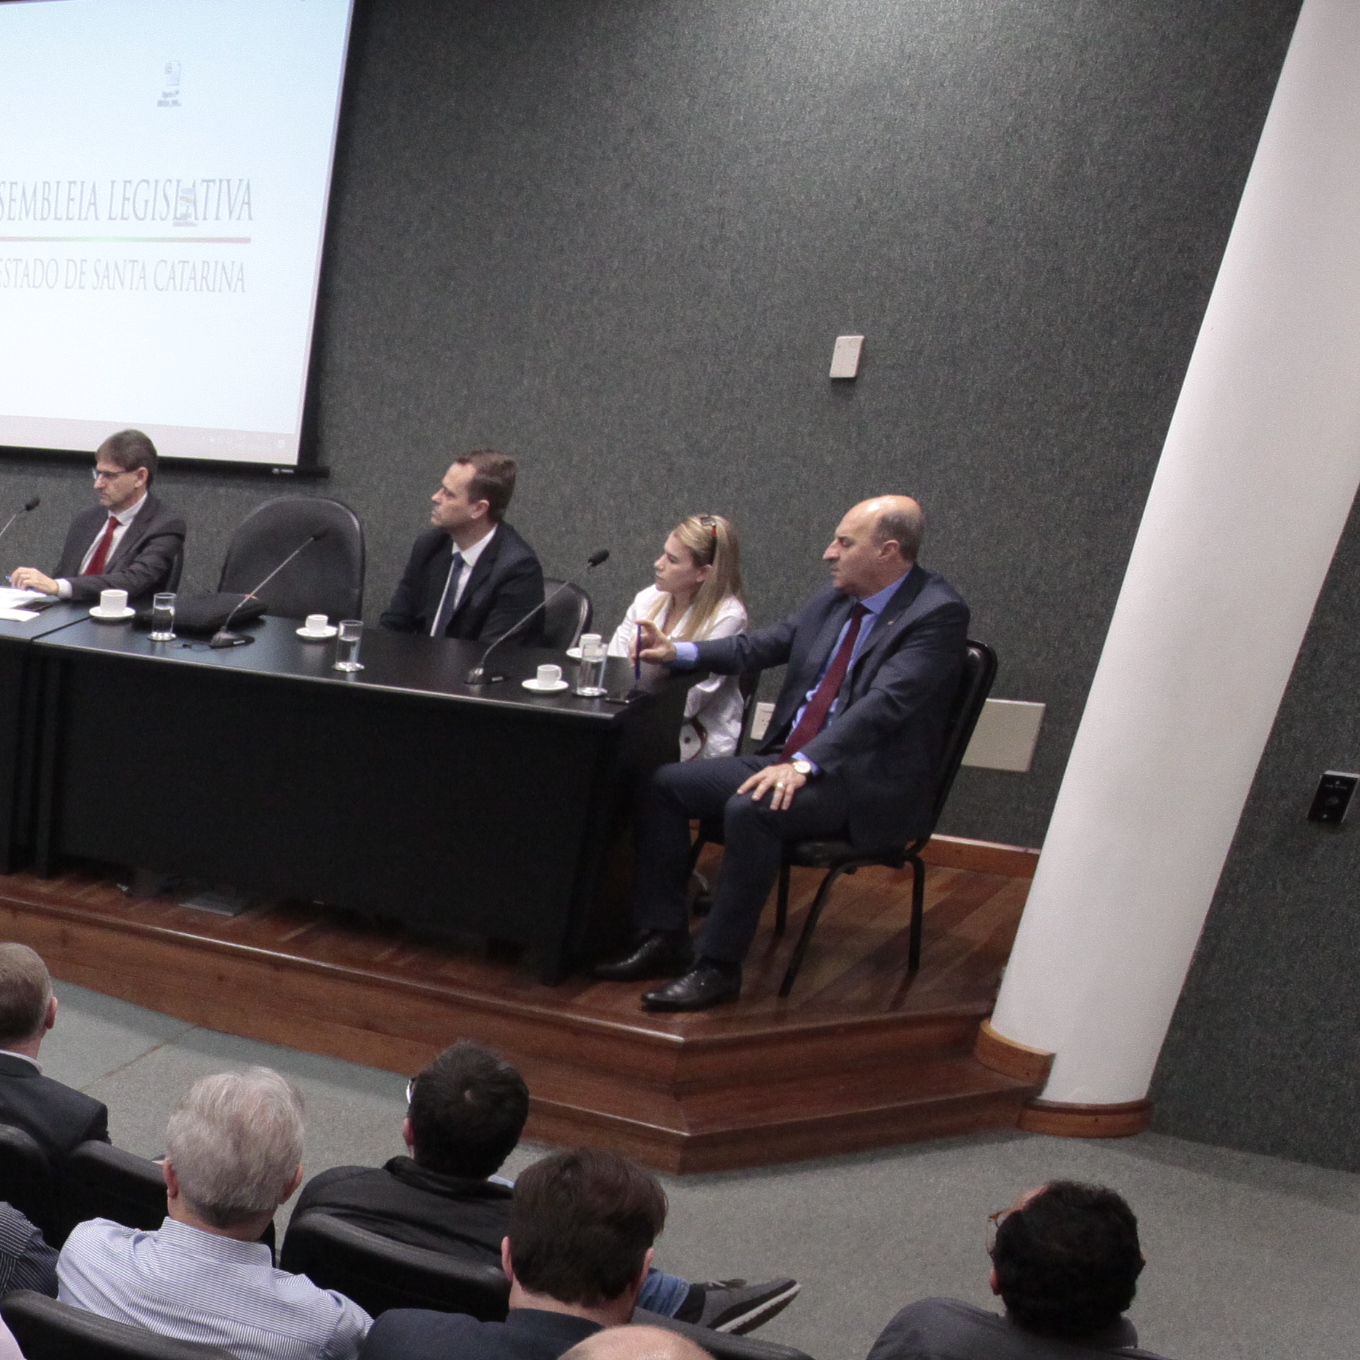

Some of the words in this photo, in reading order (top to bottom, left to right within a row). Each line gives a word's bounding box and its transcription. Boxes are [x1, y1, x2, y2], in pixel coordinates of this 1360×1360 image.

[107, 178, 254, 222] LEGISLATIVA
[64, 258, 88, 290] DE
[92, 258, 148, 291] SANTA
[153, 259, 247, 294] CATARINA
